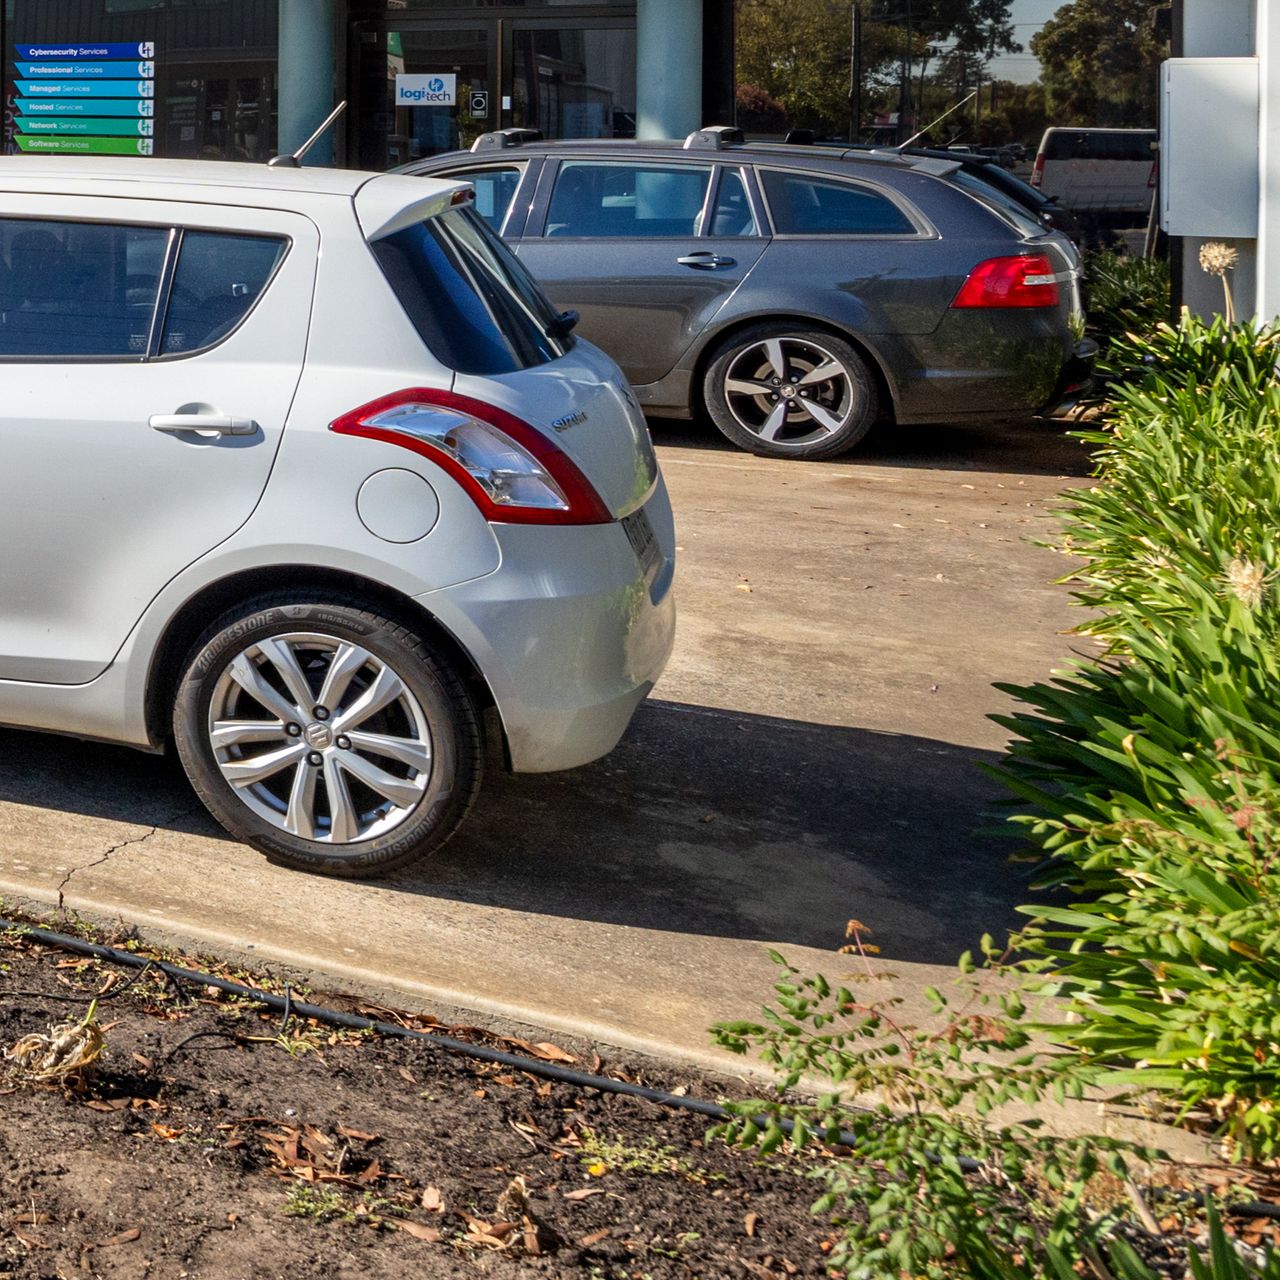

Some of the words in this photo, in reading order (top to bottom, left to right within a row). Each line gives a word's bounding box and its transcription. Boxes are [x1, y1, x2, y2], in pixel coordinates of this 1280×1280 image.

[29, 48, 78, 57] Cybersecurity
[79, 47, 108, 55] Services
[29, 84, 61, 93] Managed
[29, 103, 54, 111] Hosted
[28, 140, 59, 148] Software
[60, 141, 89, 149] Services
[199, 612, 274, 673] BRIDGESTONE
